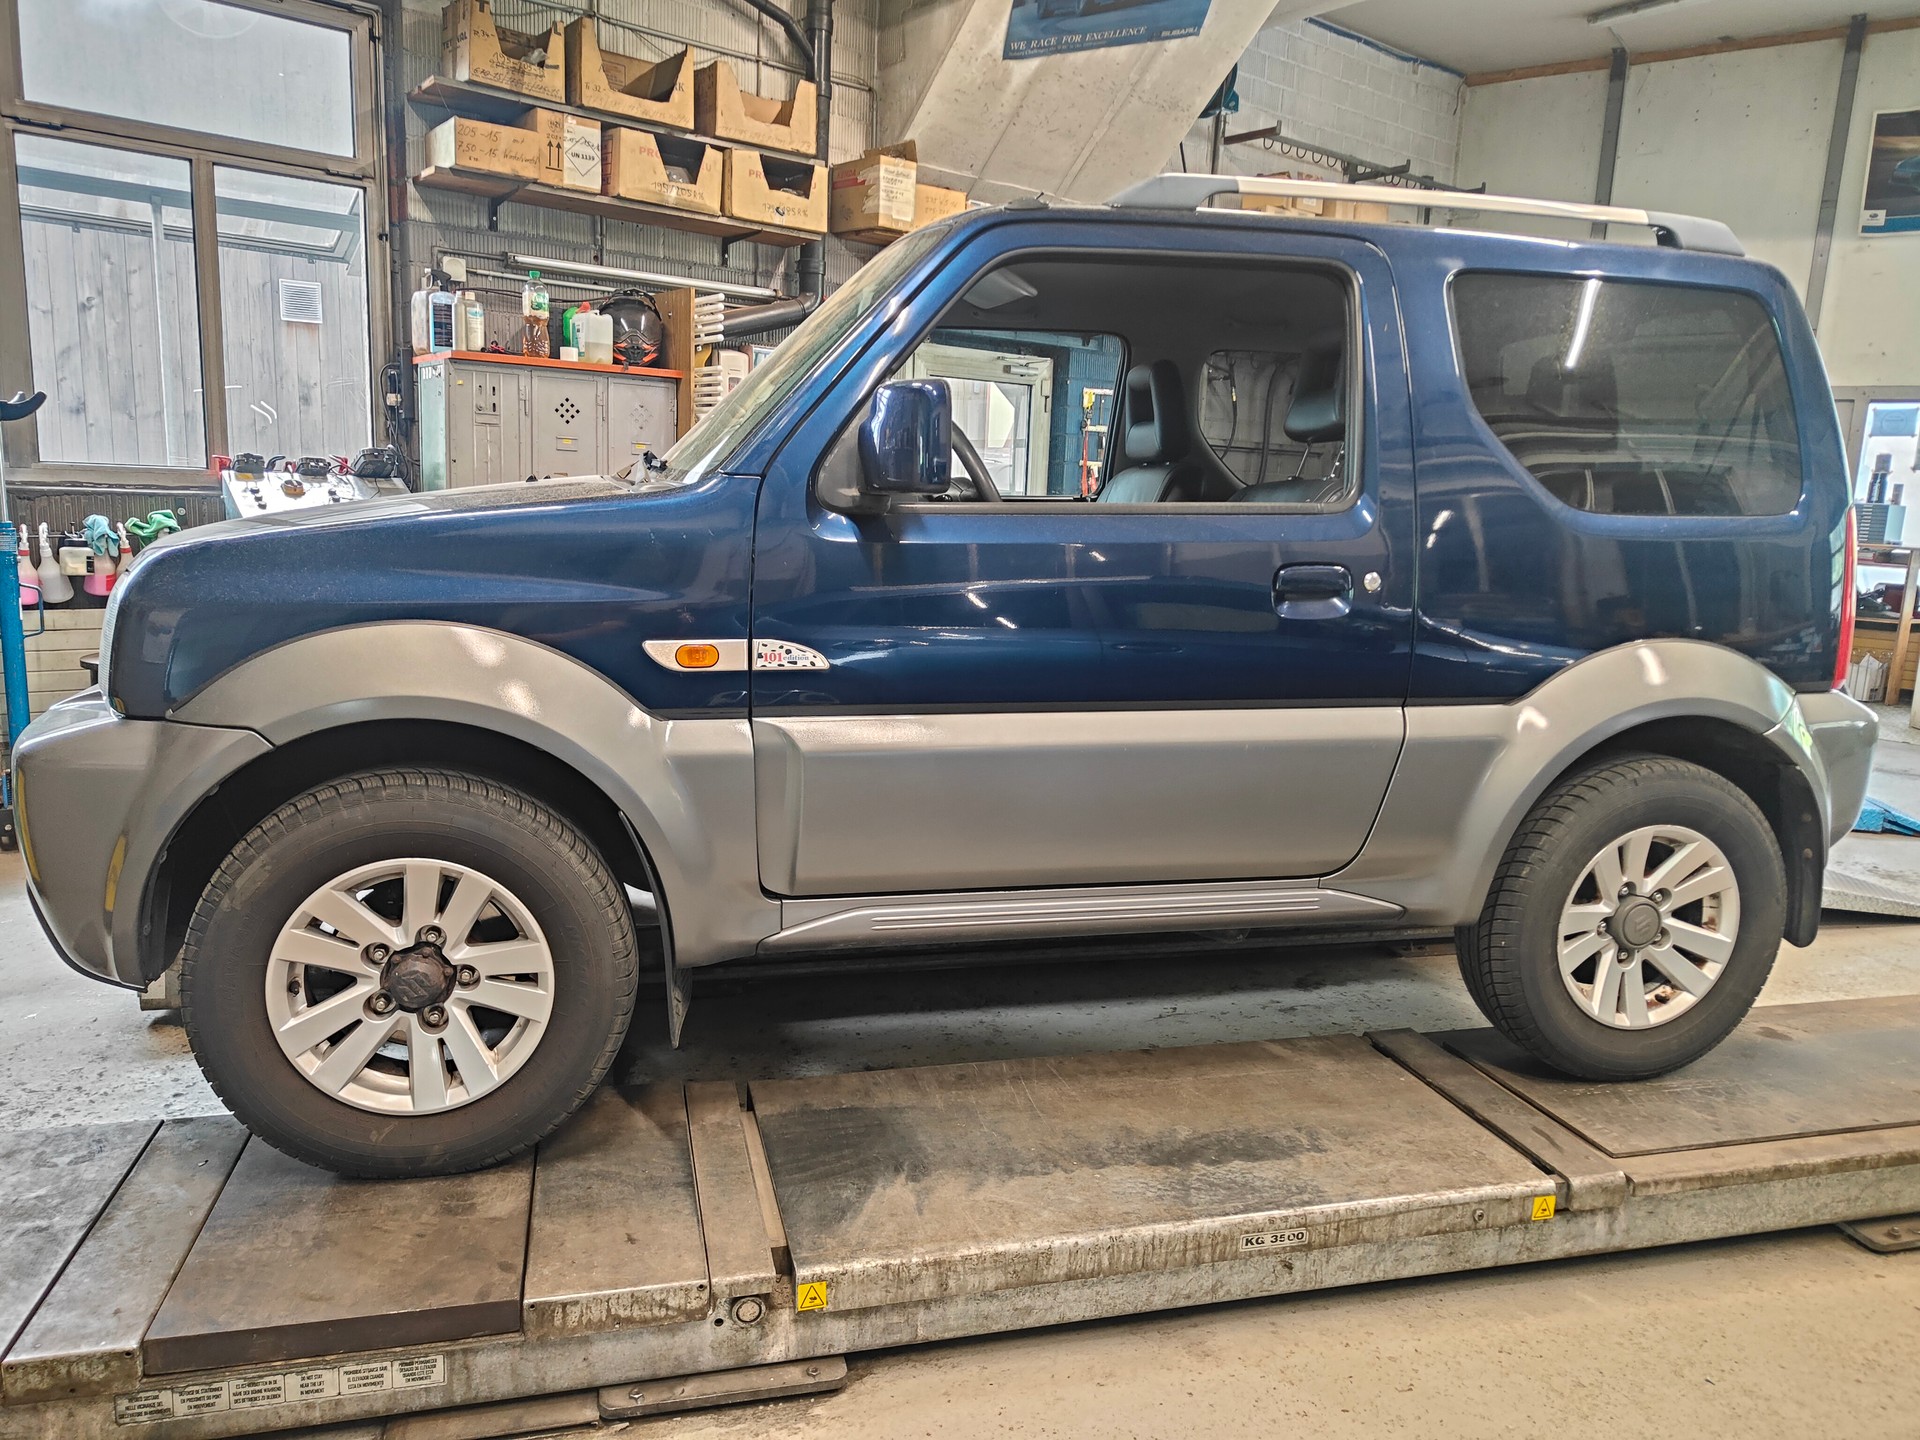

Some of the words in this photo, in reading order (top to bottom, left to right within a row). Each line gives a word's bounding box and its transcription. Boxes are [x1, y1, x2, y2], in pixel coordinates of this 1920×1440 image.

[1161, 26, 1198, 36] SUBARU
[1010, 40, 1027, 51] WE
[1030, 36, 1058, 49] RACE
[1062, 34, 1083, 44] FOR
[1085, 26, 1148, 41] EXCELLENCE
[570, 151, 580, 160] UN
[763, 652, 783, 662] 101
[1244, 1236, 1265, 1247] KG
[1270, 1231, 1305, 1244] 3500
